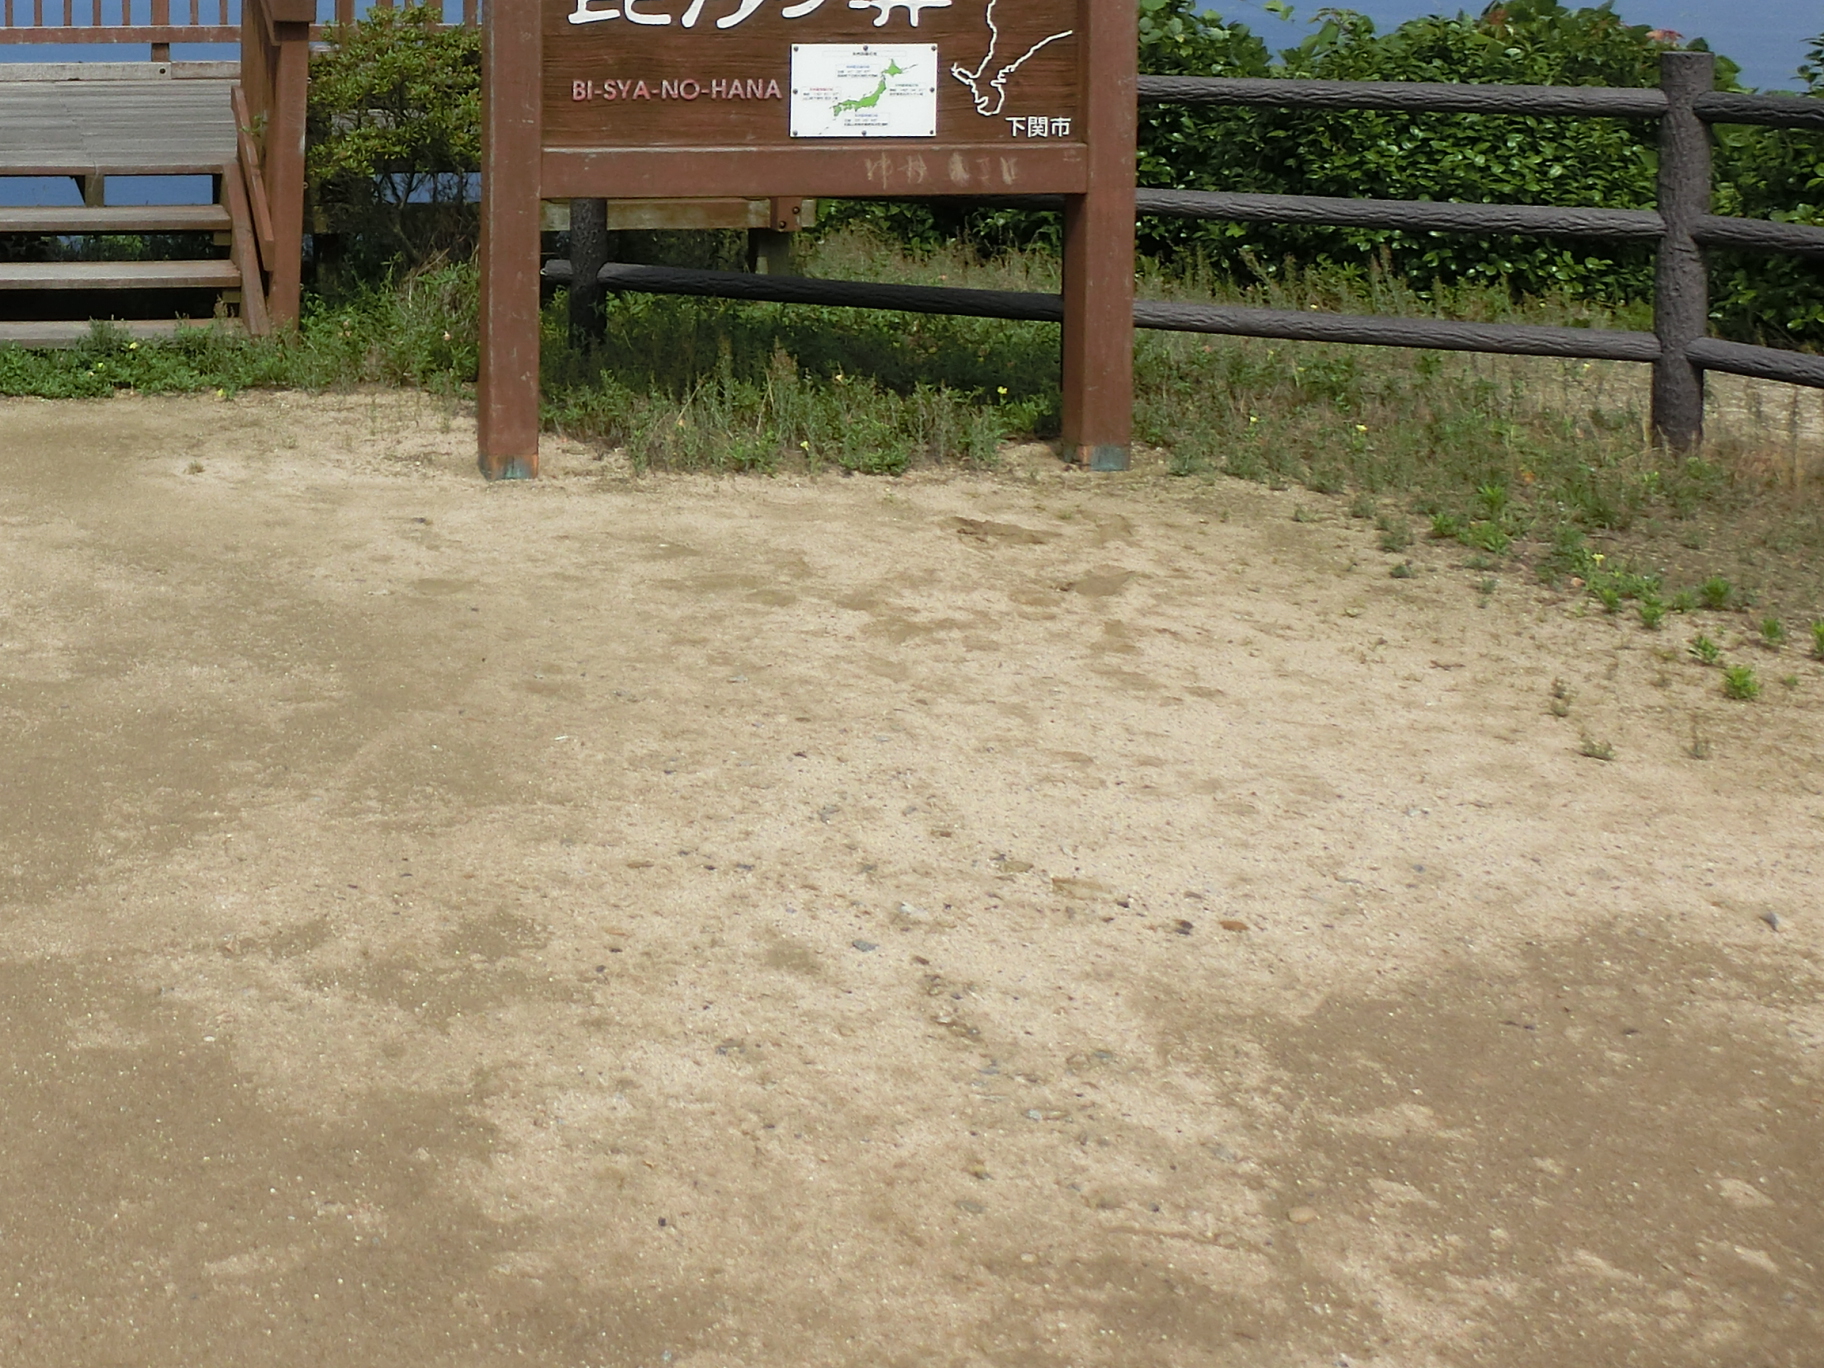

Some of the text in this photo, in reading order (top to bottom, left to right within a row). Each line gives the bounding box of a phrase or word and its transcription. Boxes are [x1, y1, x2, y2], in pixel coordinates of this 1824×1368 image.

[572, 79, 782, 102] BI-SYA-NO-HANA
[1005, 117, 1072, 137] 下関市
